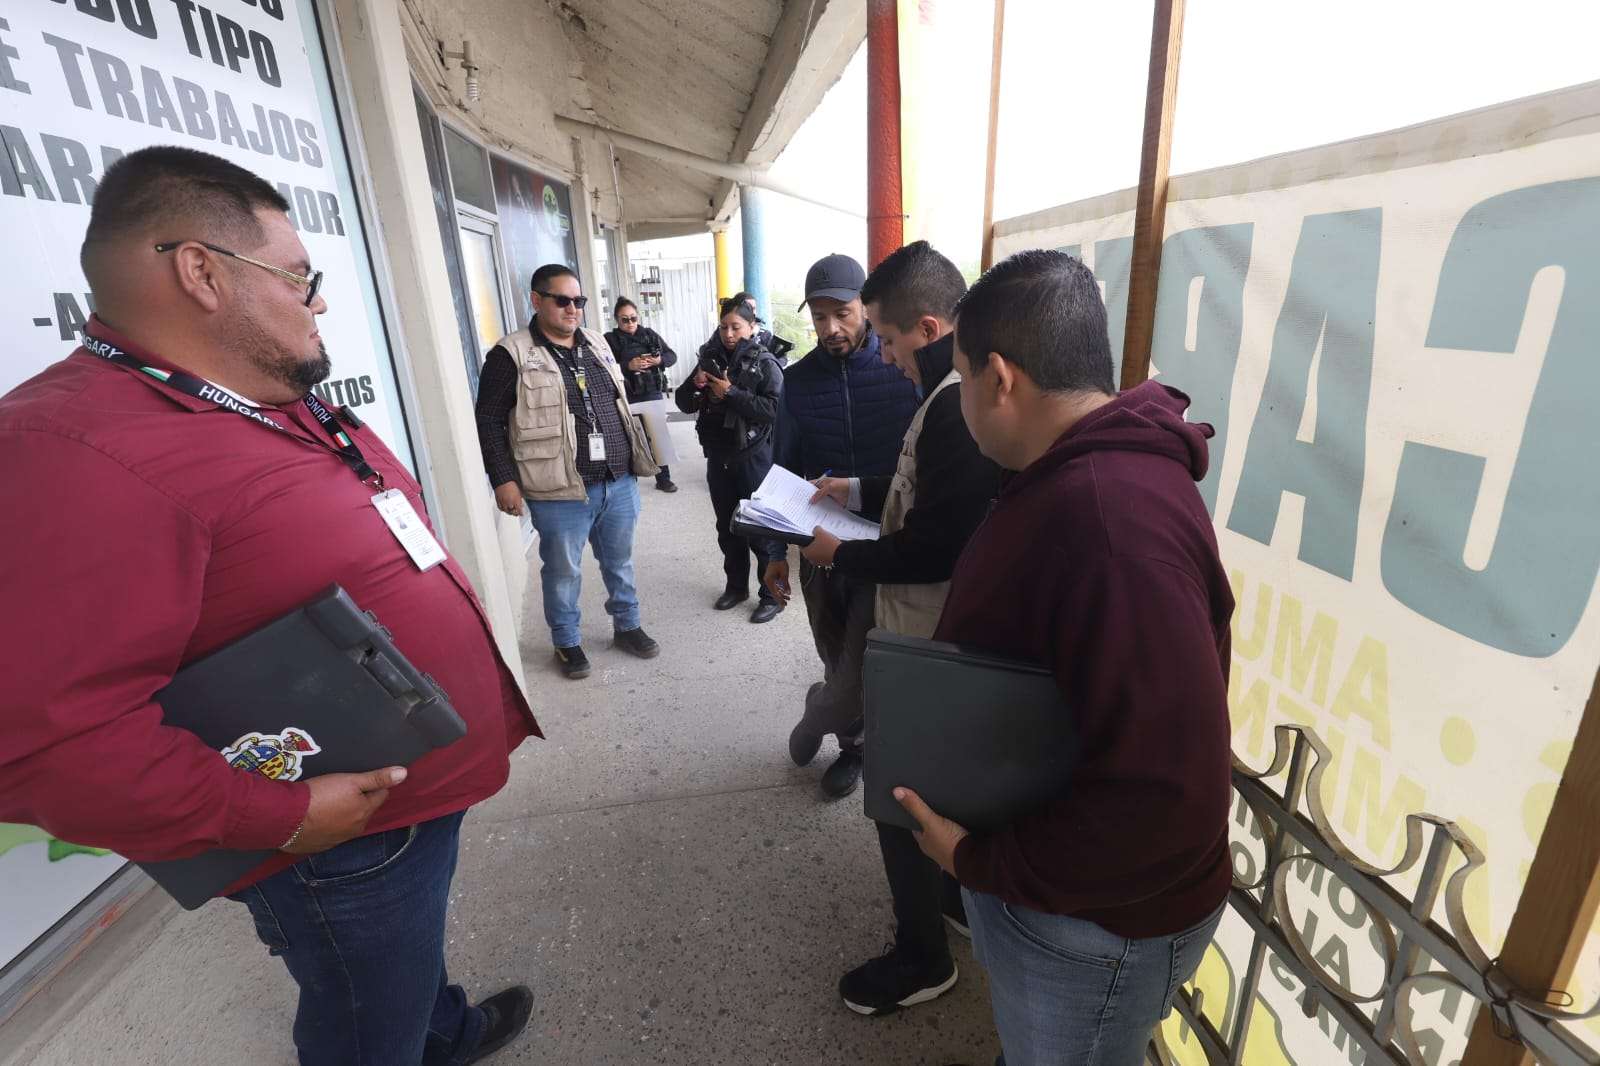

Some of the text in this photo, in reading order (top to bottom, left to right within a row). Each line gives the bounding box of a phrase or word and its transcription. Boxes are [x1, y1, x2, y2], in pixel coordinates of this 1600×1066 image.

[170, 0, 282, 88] TIPO
[41, 31, 323, 168] TRABAJOS
[198, 384, 285, 430] HUNGARY
